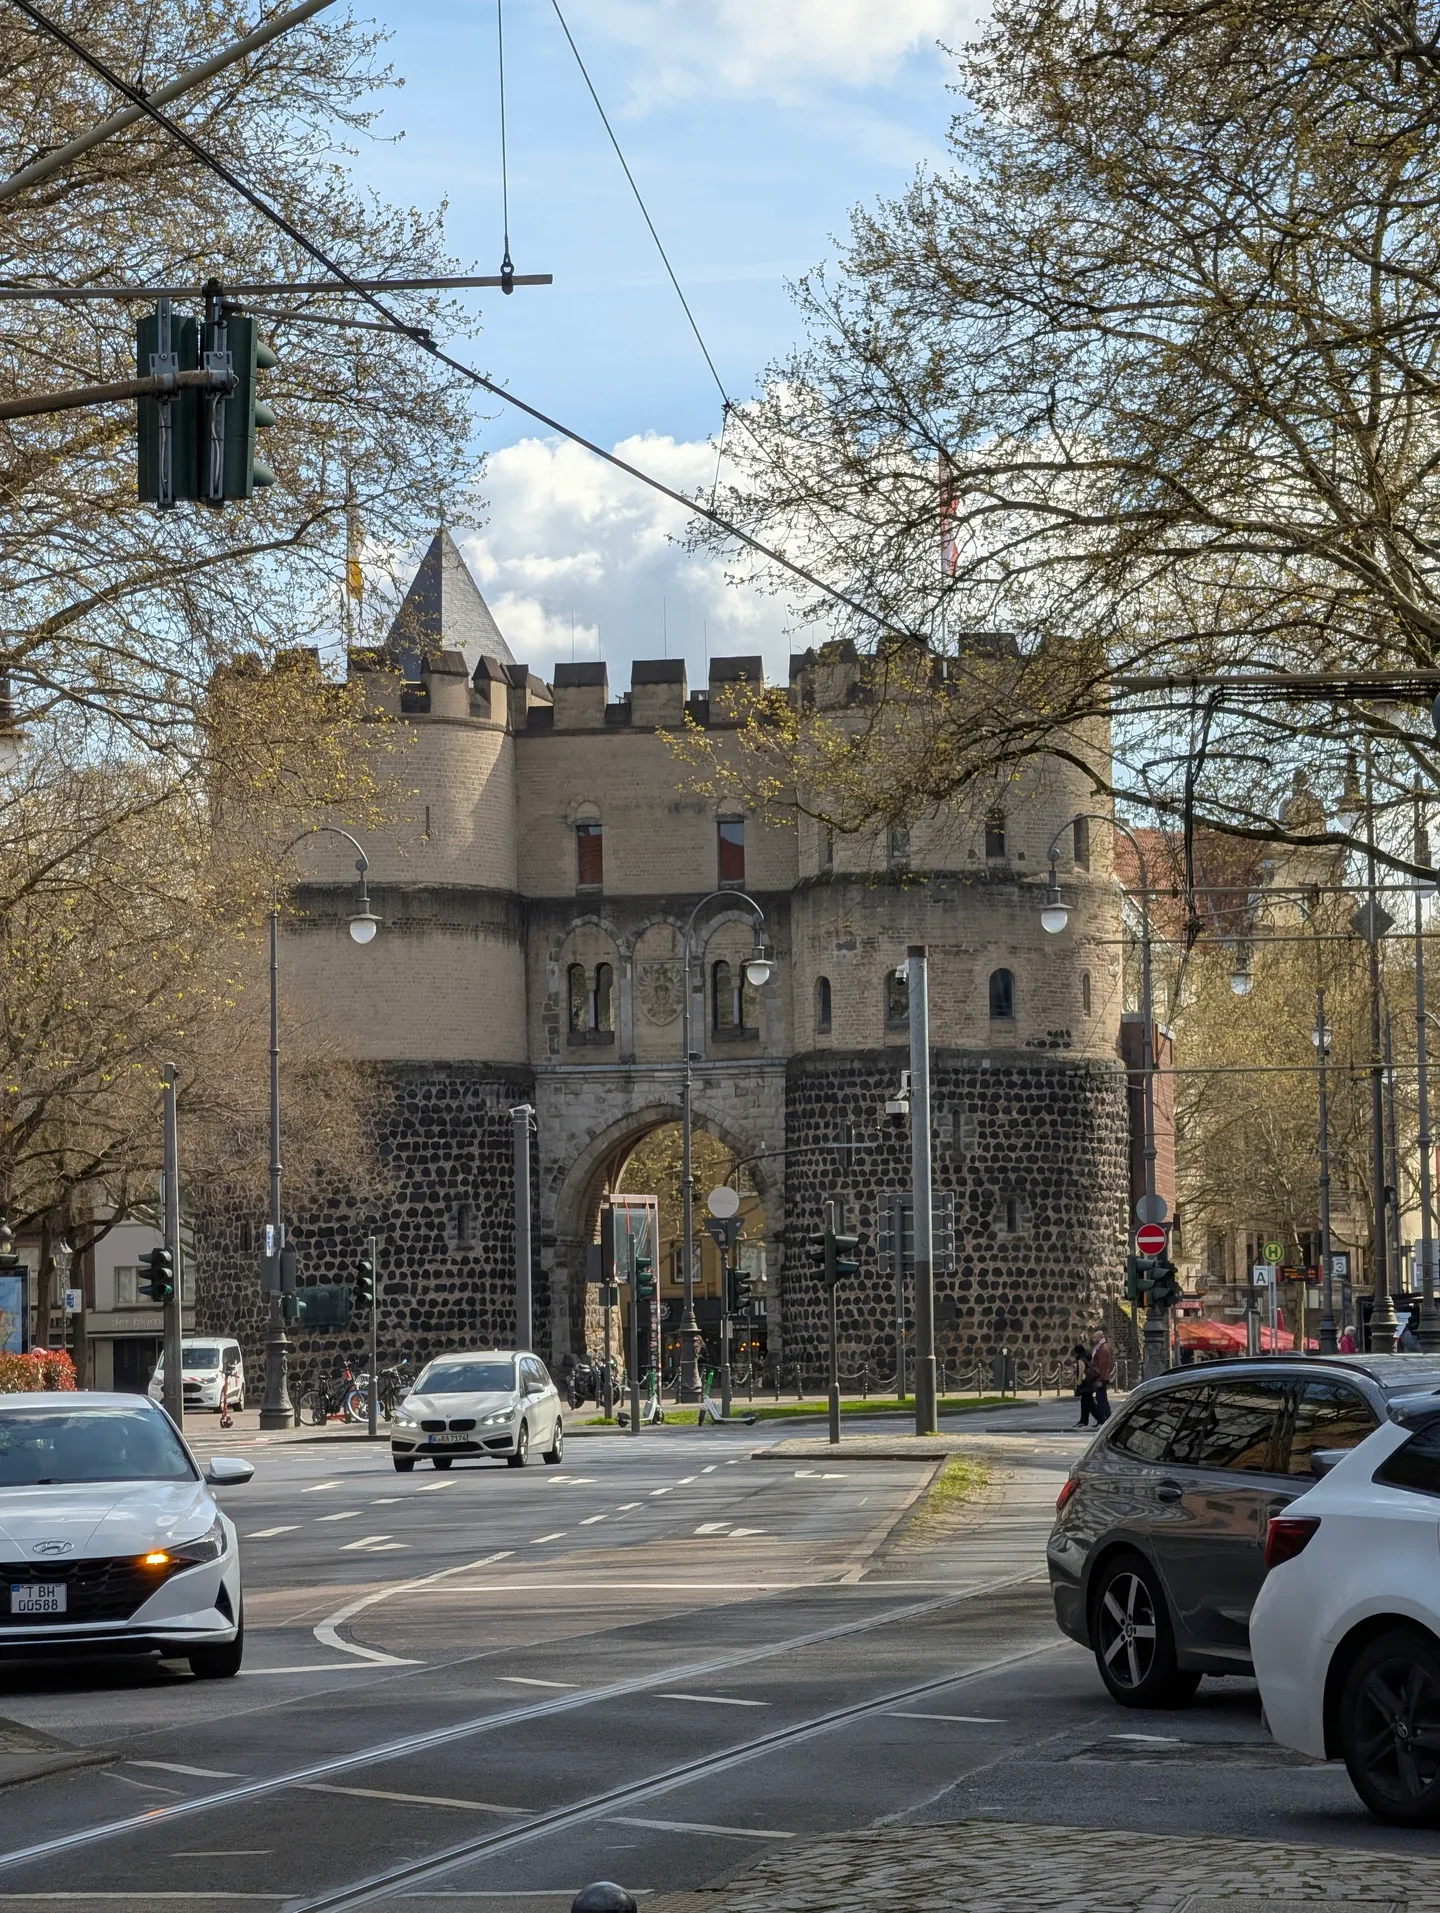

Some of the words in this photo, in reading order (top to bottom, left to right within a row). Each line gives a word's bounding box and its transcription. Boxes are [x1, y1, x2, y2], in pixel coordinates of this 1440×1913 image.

[1268, 1246, 1279, 1258] H
[1335, 1261, 1345, 1273] 3
[1255, 1271, 1267, 1284] A
[25, 1586, 35, 1598] T
[38, 1586, 55, 1598] BH
[18, 1599, 59, 1611] 00588
